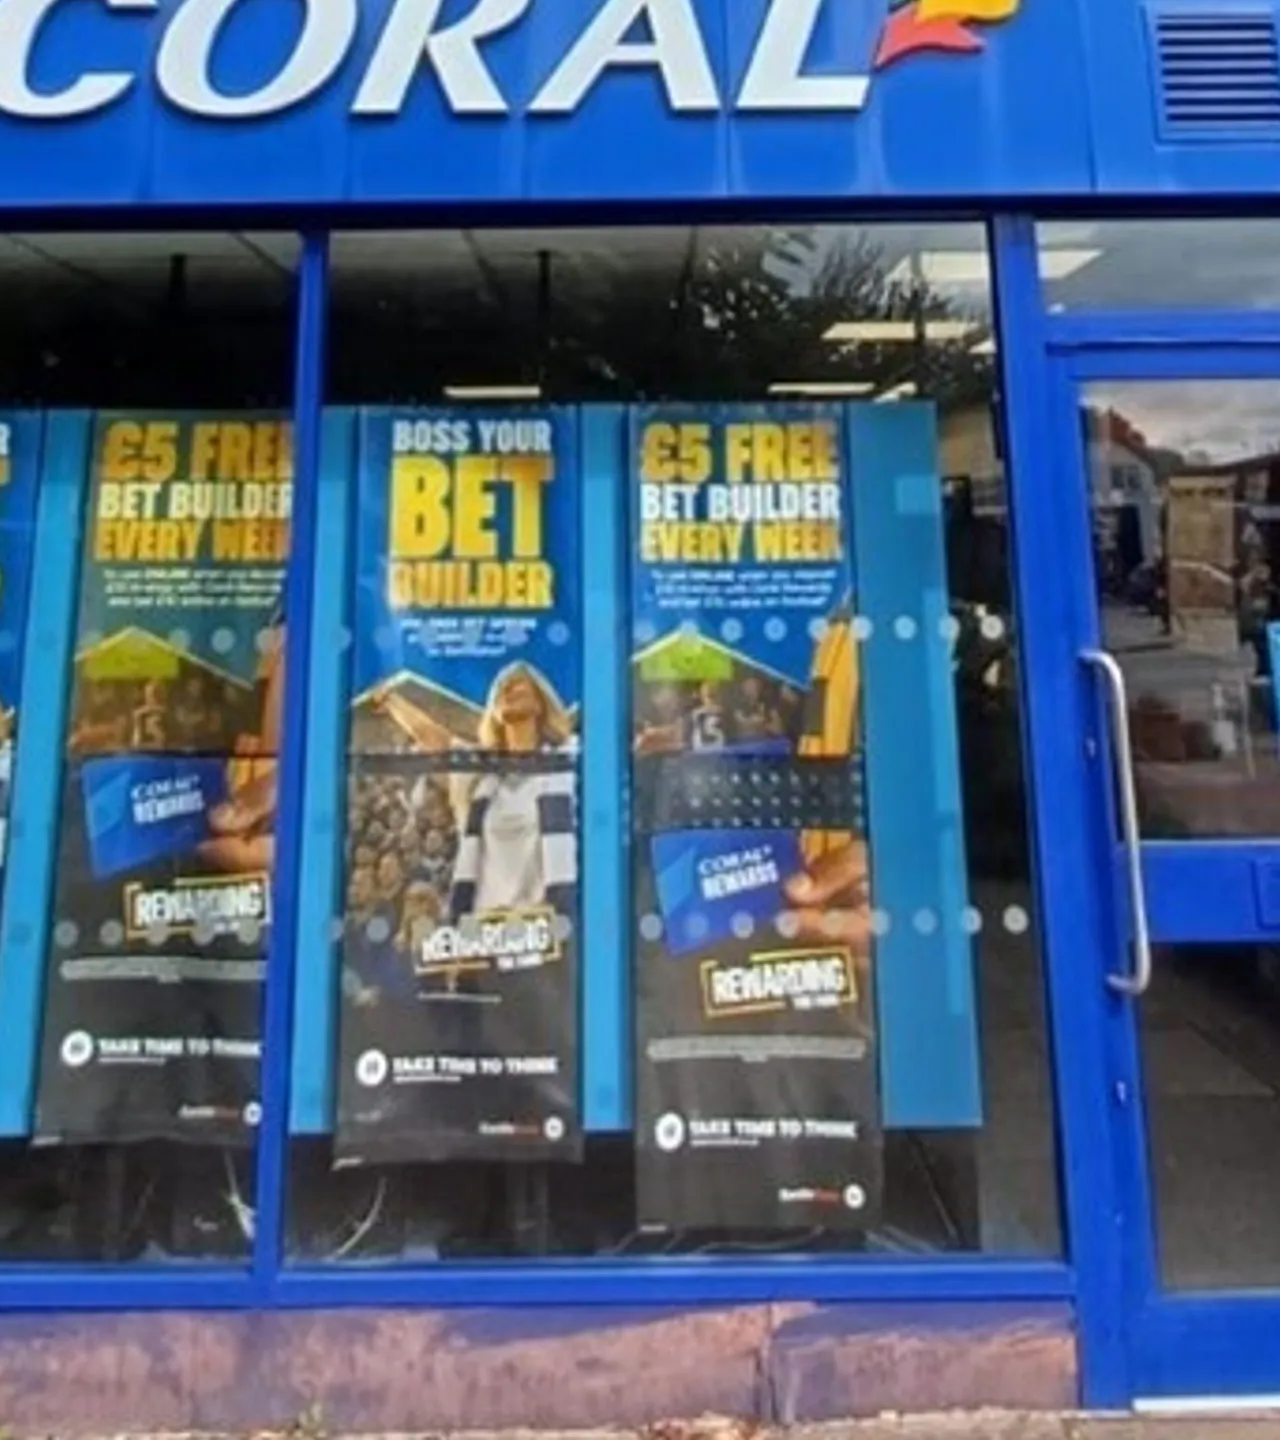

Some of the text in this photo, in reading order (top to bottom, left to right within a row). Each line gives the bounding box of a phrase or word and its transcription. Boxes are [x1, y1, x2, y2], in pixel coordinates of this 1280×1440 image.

[102, 421, 179, 482] £5
[393, 419, 553, 453] BOSS YOUR
[641, 421, 839, 483] £5 FREE
[98, 481, 162, 519] BET
[389, 454, 555, 559] BET
[639, 482, 840, 521] BET BUILDER
[94, 519, 205, 561] EVERY
[640, 520, 842, 563] EVERY WEEK
[388, 560, 555, 610] BUILDER
[701, 861, 780, 901] REWARDS
[135, 882, 263, 928] REWARDING
[711, 956, 846, 1004] REWARDING
[186, 1037, 210, 1057] TO
[479, 1056, 503, 1074] TO
[778, 1119, 802, 1138] TO
